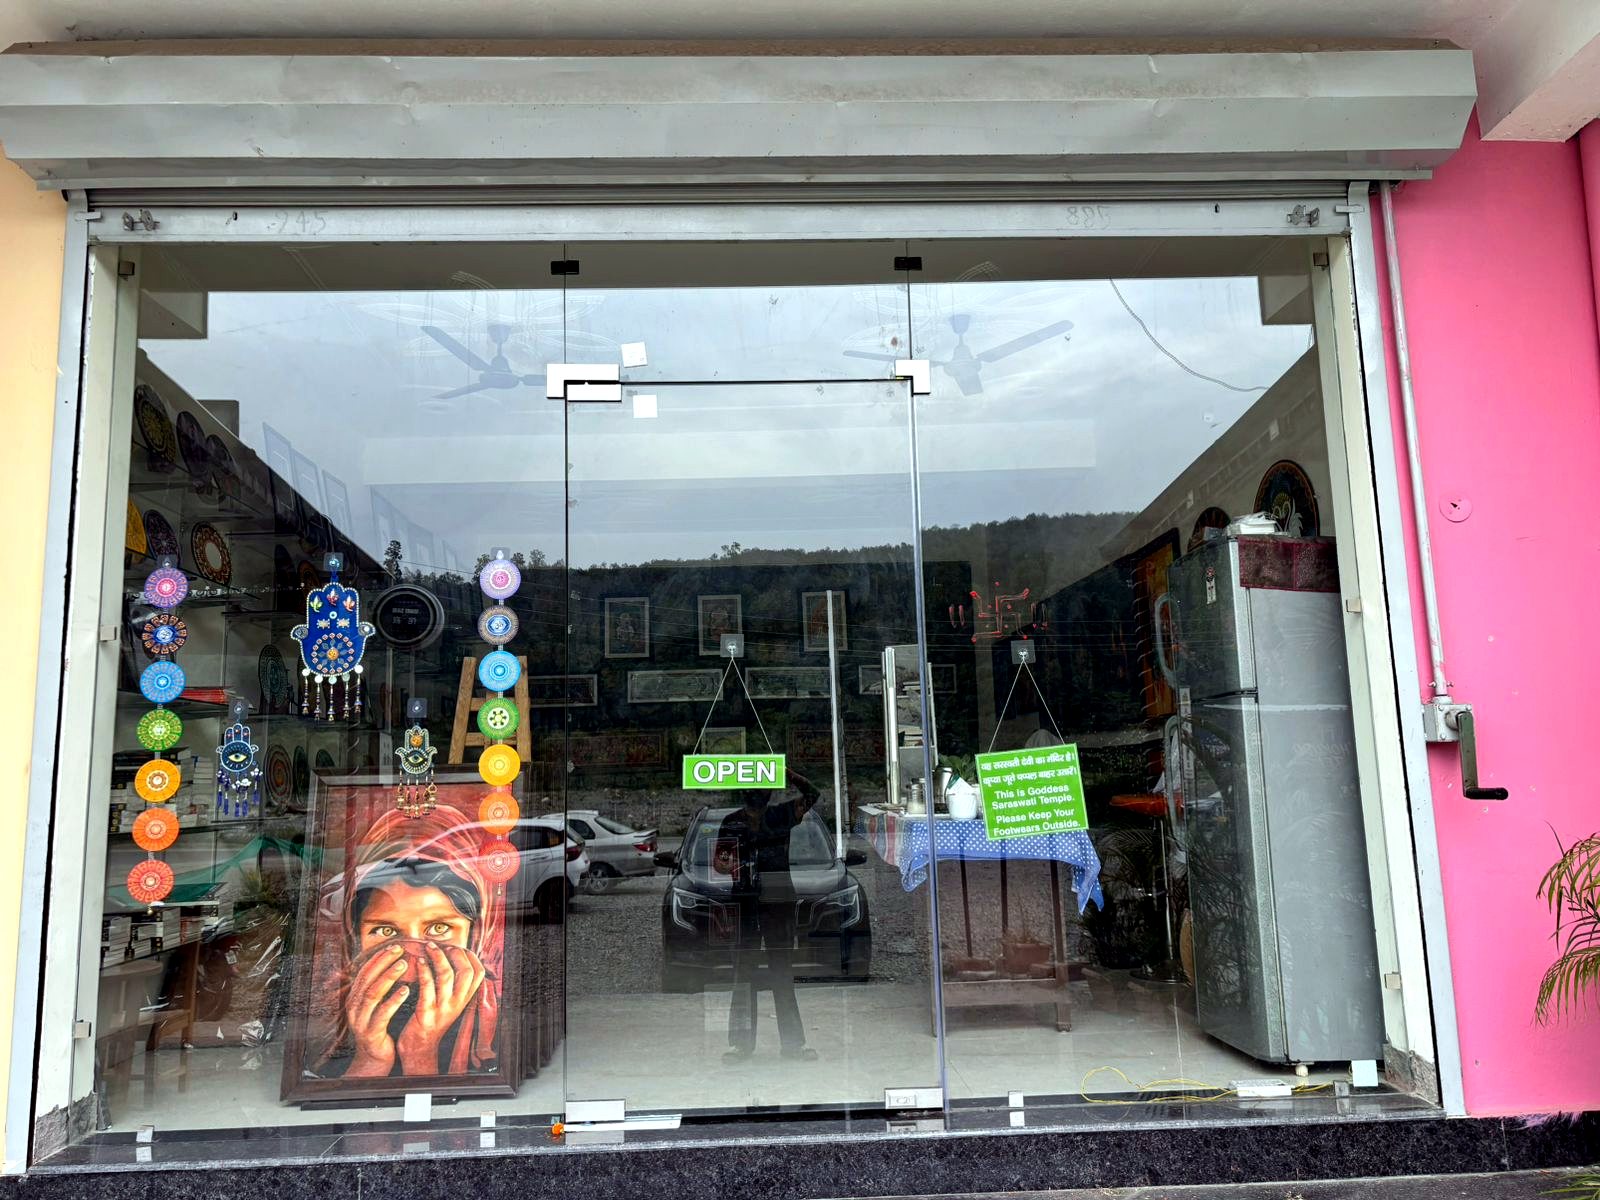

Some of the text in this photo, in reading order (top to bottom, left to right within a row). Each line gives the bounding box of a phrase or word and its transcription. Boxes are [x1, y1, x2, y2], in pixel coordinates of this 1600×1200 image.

[981, 762, 992, 771] यह
[993, 757, 1020, 769] सरस्वती
[1021, 755, 1034, 765] देवी
[693, 760, 776, 783] OPEN
[1038, 769, 1056, 778] बाहर
[994, 790, 1014, 799] This
[1027, 785, 1069, 796] Goddess
[992, 794, 1075, 810] Saraswati Temple.
[996, 808, 1075, 824] Please Keep Your
[993, 819, 1081, 836] Footwears Outside.
